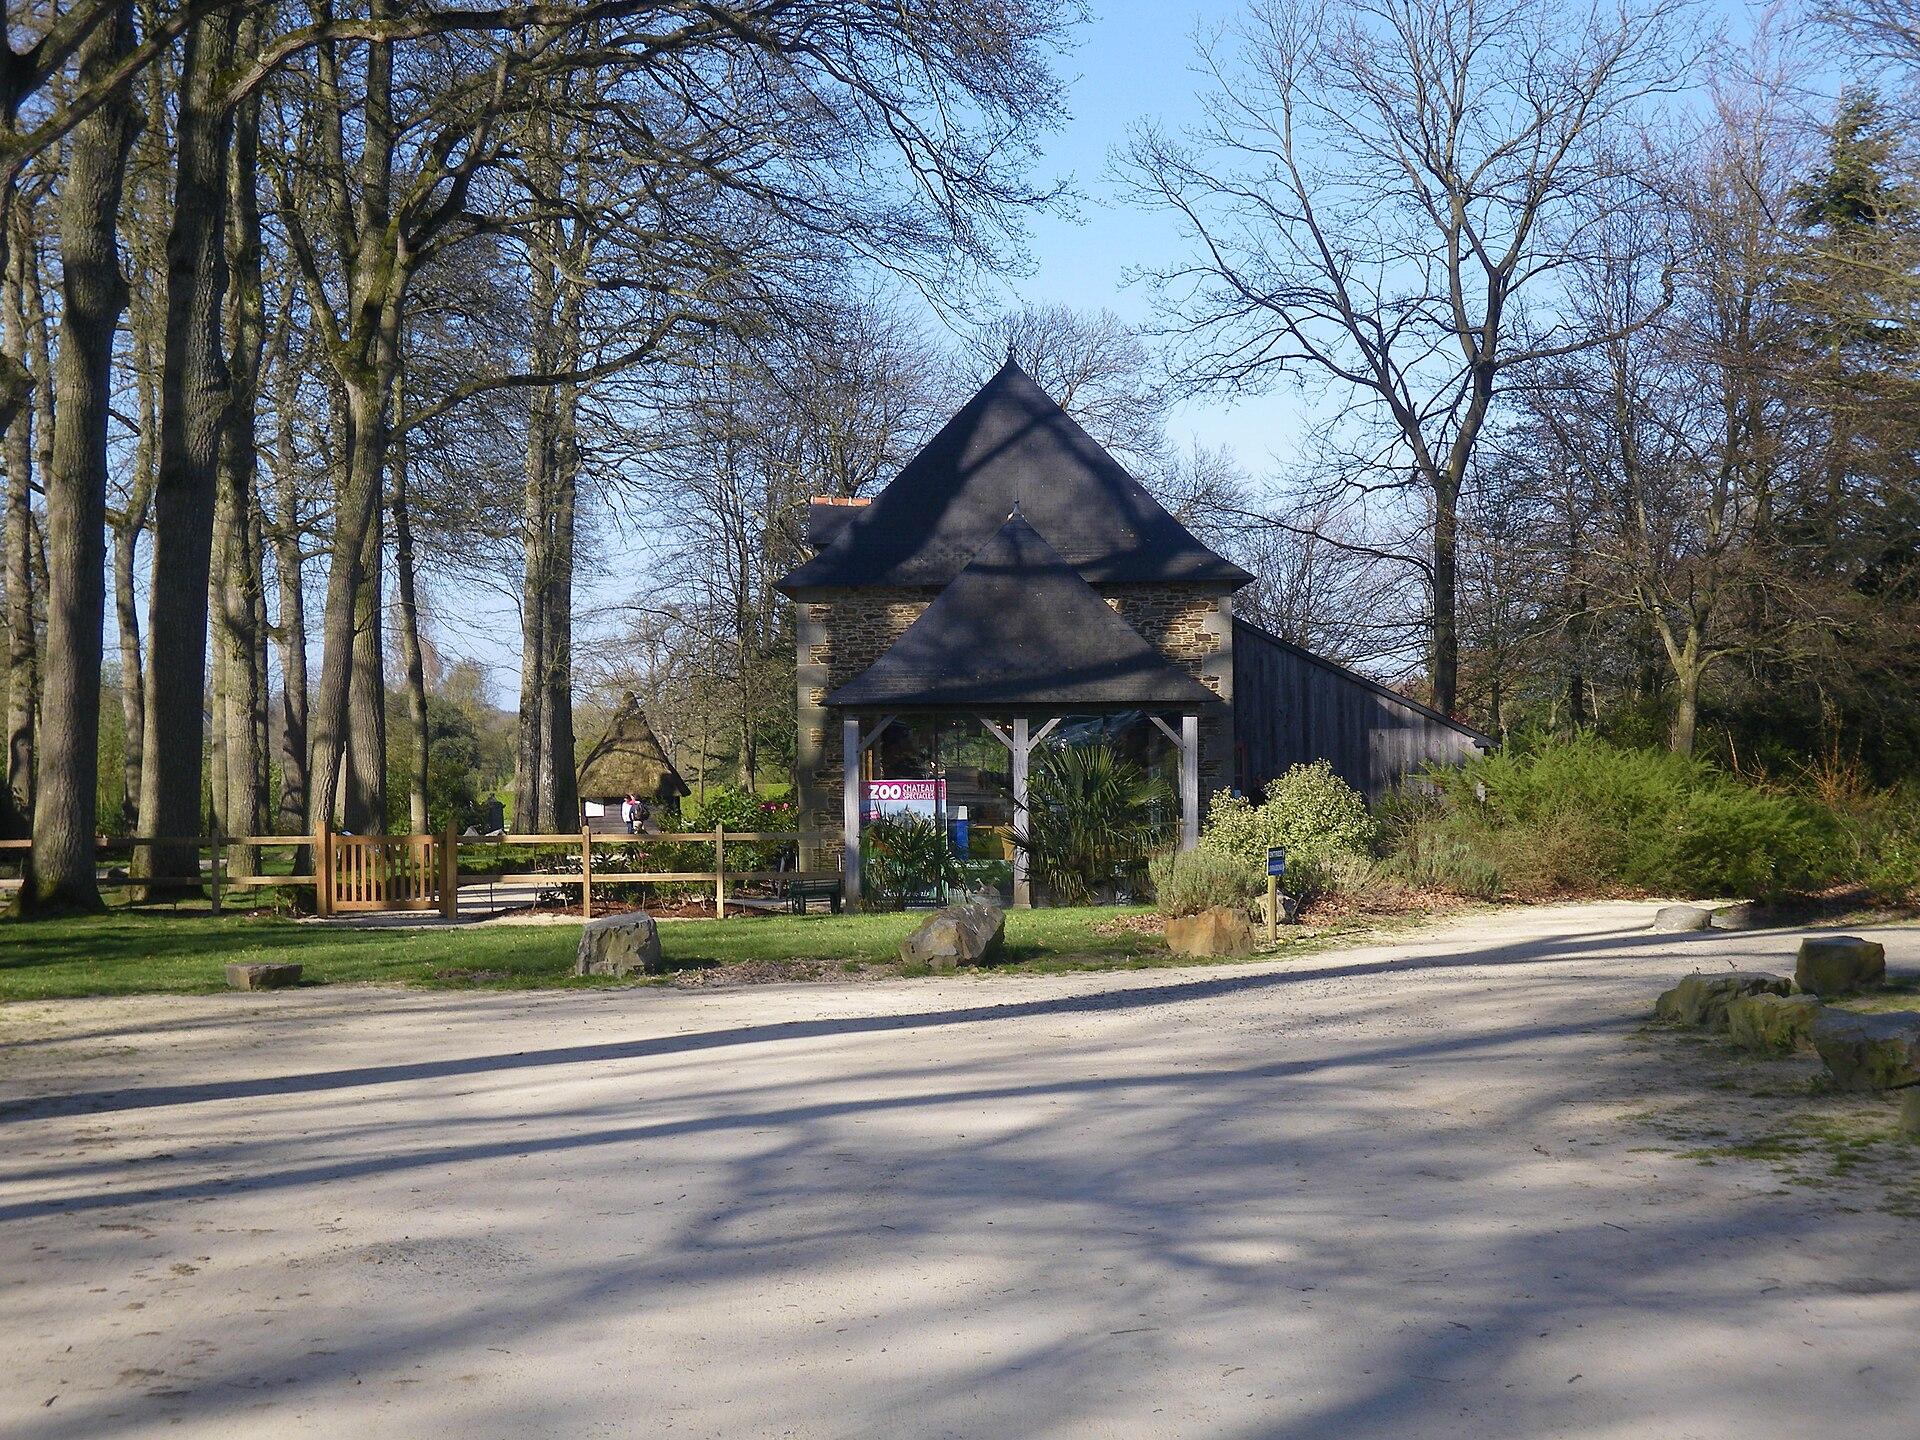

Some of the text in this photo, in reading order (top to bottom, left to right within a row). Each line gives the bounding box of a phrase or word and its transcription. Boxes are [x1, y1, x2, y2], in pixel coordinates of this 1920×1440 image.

[870, 784, 902, 800] ZOO
[902, 784, 935, 792] CHATEAU
[902, 792, 935, 800] SPECTACLES
